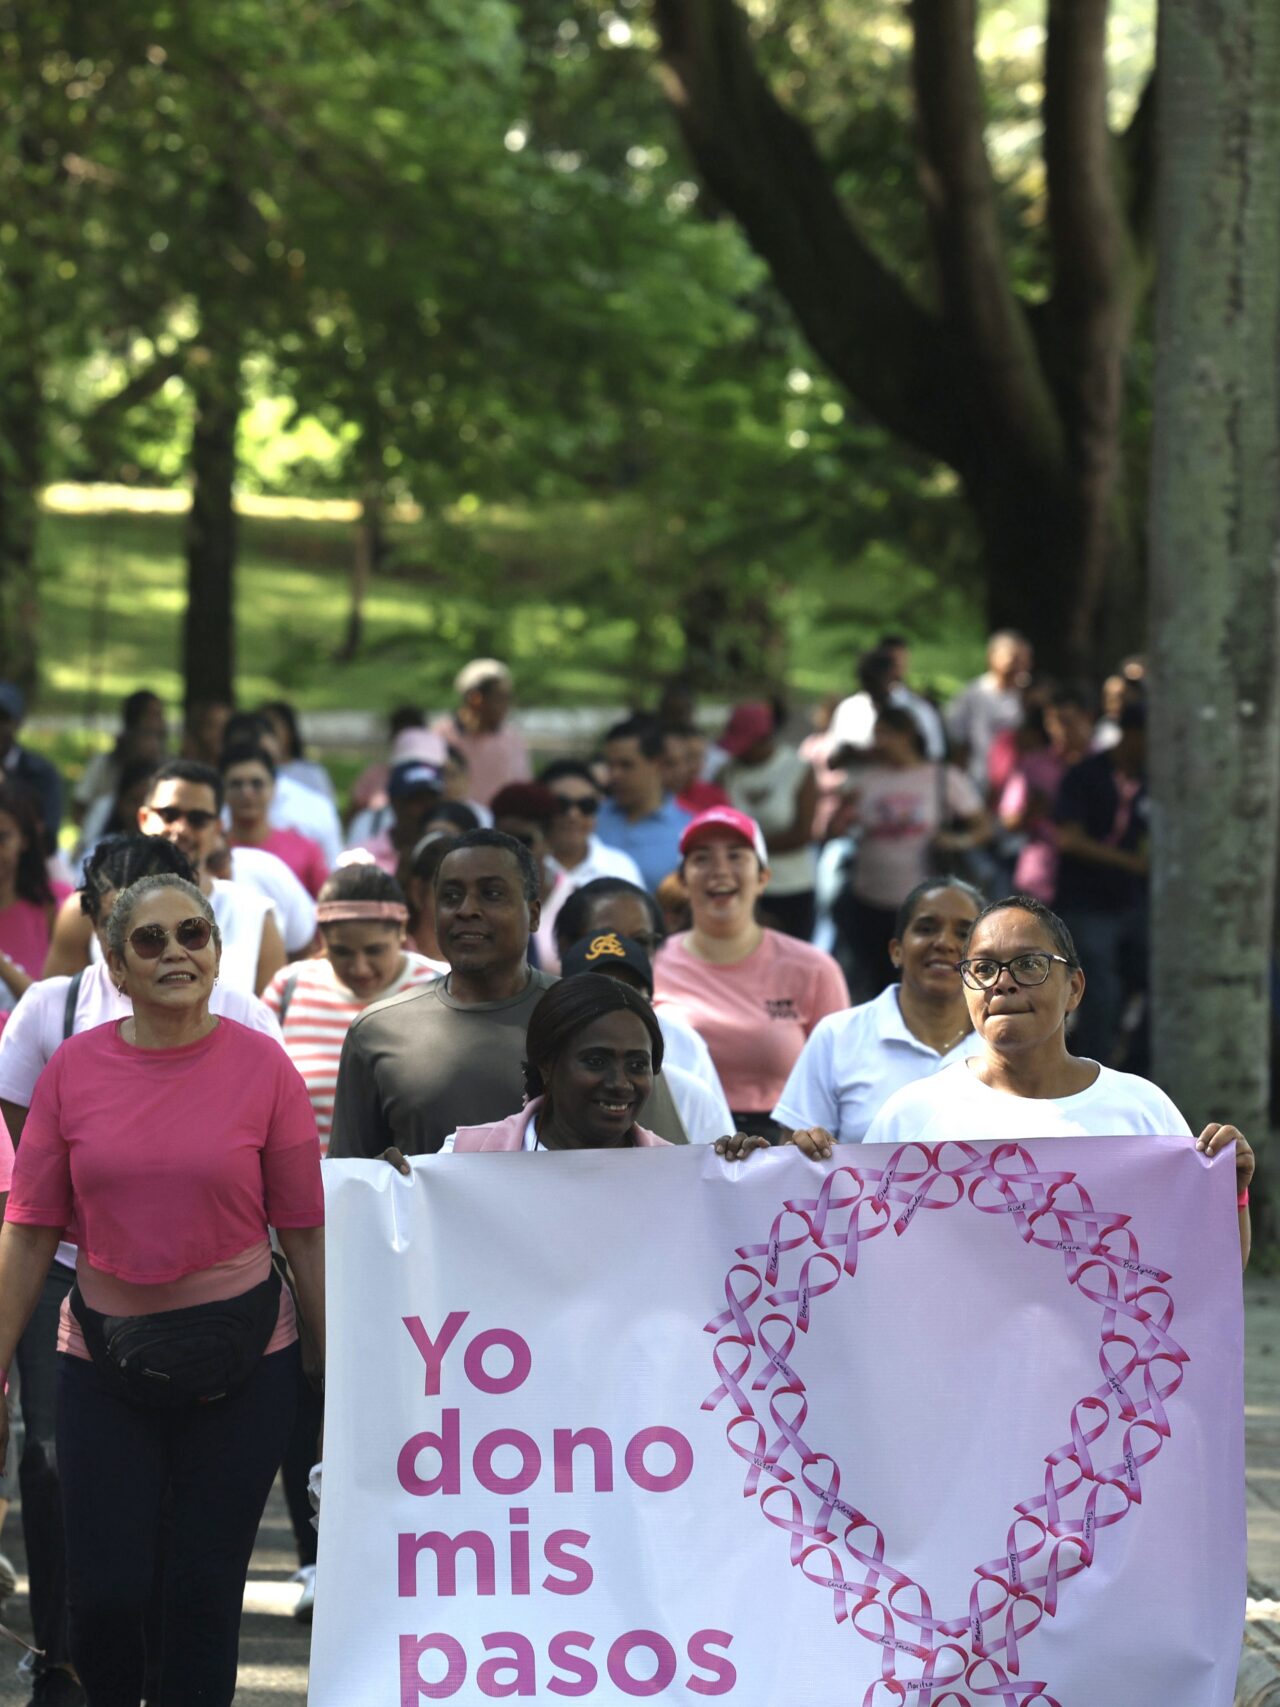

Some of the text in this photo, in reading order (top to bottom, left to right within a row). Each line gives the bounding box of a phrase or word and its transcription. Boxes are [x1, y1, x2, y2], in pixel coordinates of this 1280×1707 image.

[401, 1311, 532, 1396] Yo
[397, 1408, 694, 1497] dono
[398, 1507, 594, 1597] mis
[399, 1629, 738, 1707] pasos
